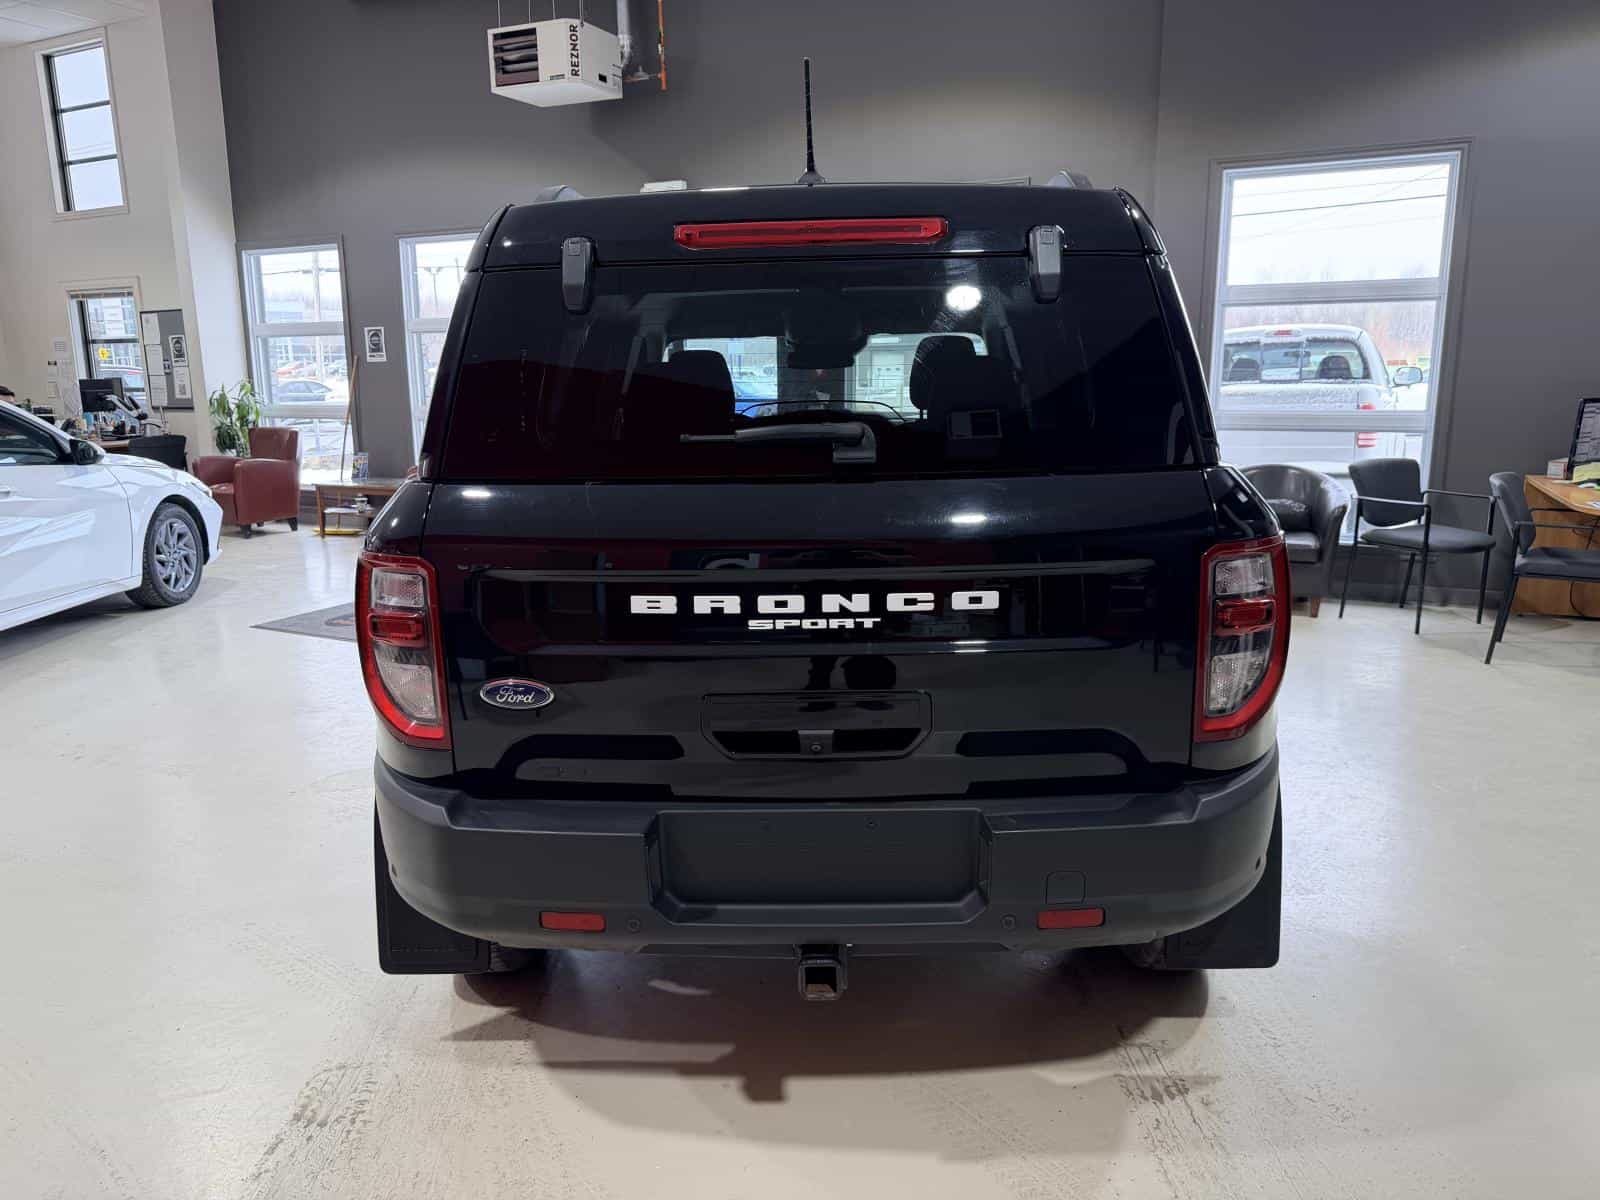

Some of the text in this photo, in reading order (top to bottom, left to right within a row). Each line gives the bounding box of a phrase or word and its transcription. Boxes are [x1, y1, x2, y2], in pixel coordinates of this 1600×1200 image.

[569, 24, 580, 77] REZNOR
[630, 590, 1000, 615] BRONCO
[748, 617, 881, 630] SPORT
[496, 685, 536, 703] Ford
